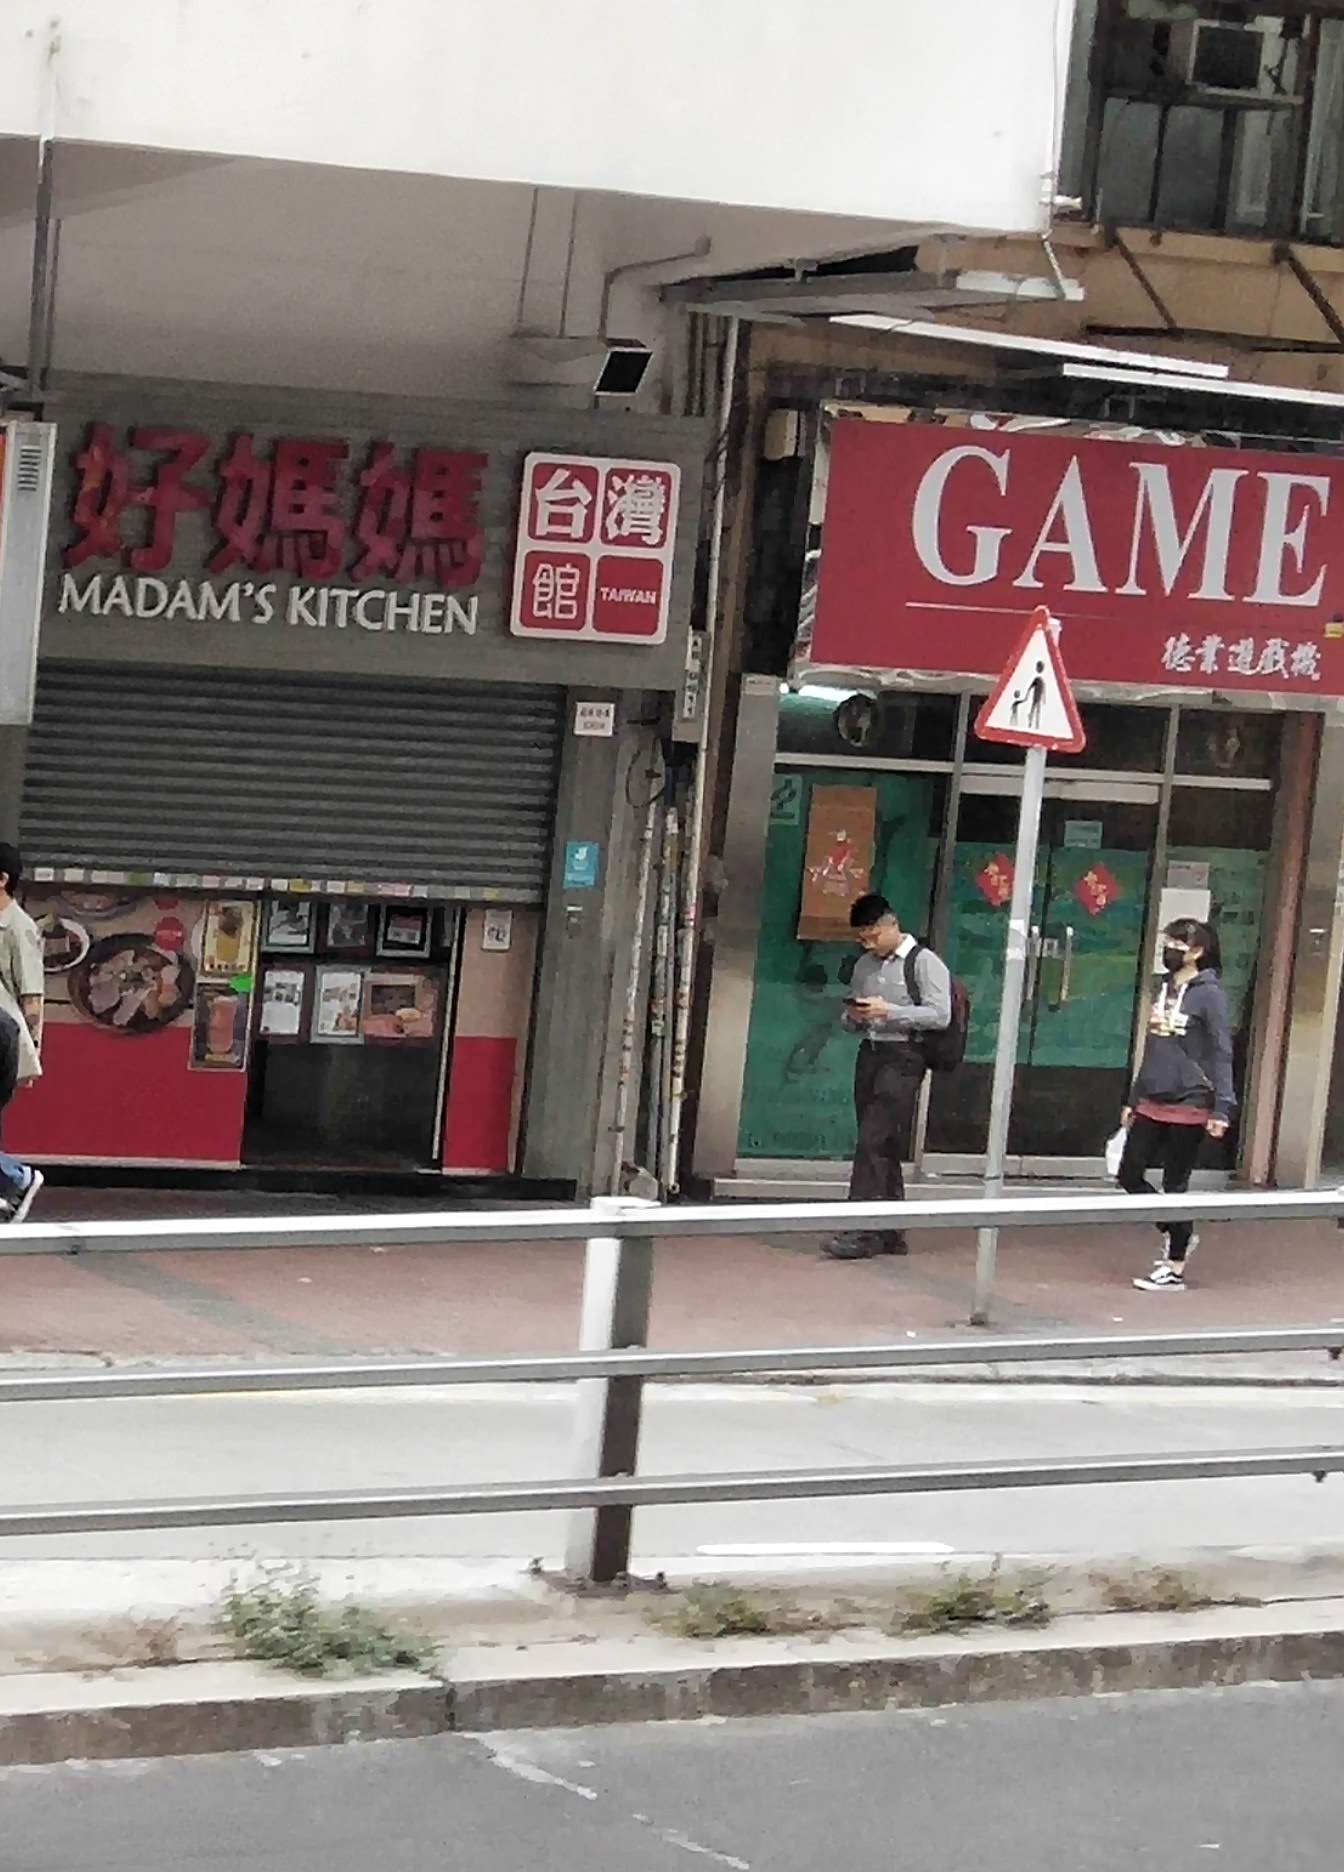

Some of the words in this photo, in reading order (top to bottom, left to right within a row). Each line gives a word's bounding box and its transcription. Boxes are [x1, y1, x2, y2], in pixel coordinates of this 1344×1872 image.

[63, 422, 489, 590] 好媽媽
[912, 444, 1331, 606] GAME
[57, 572, 275, 625] MADAM'S
[287, 584, 479, 635] KITCHEN
[600, 587, 657, 605] TAIWAN
